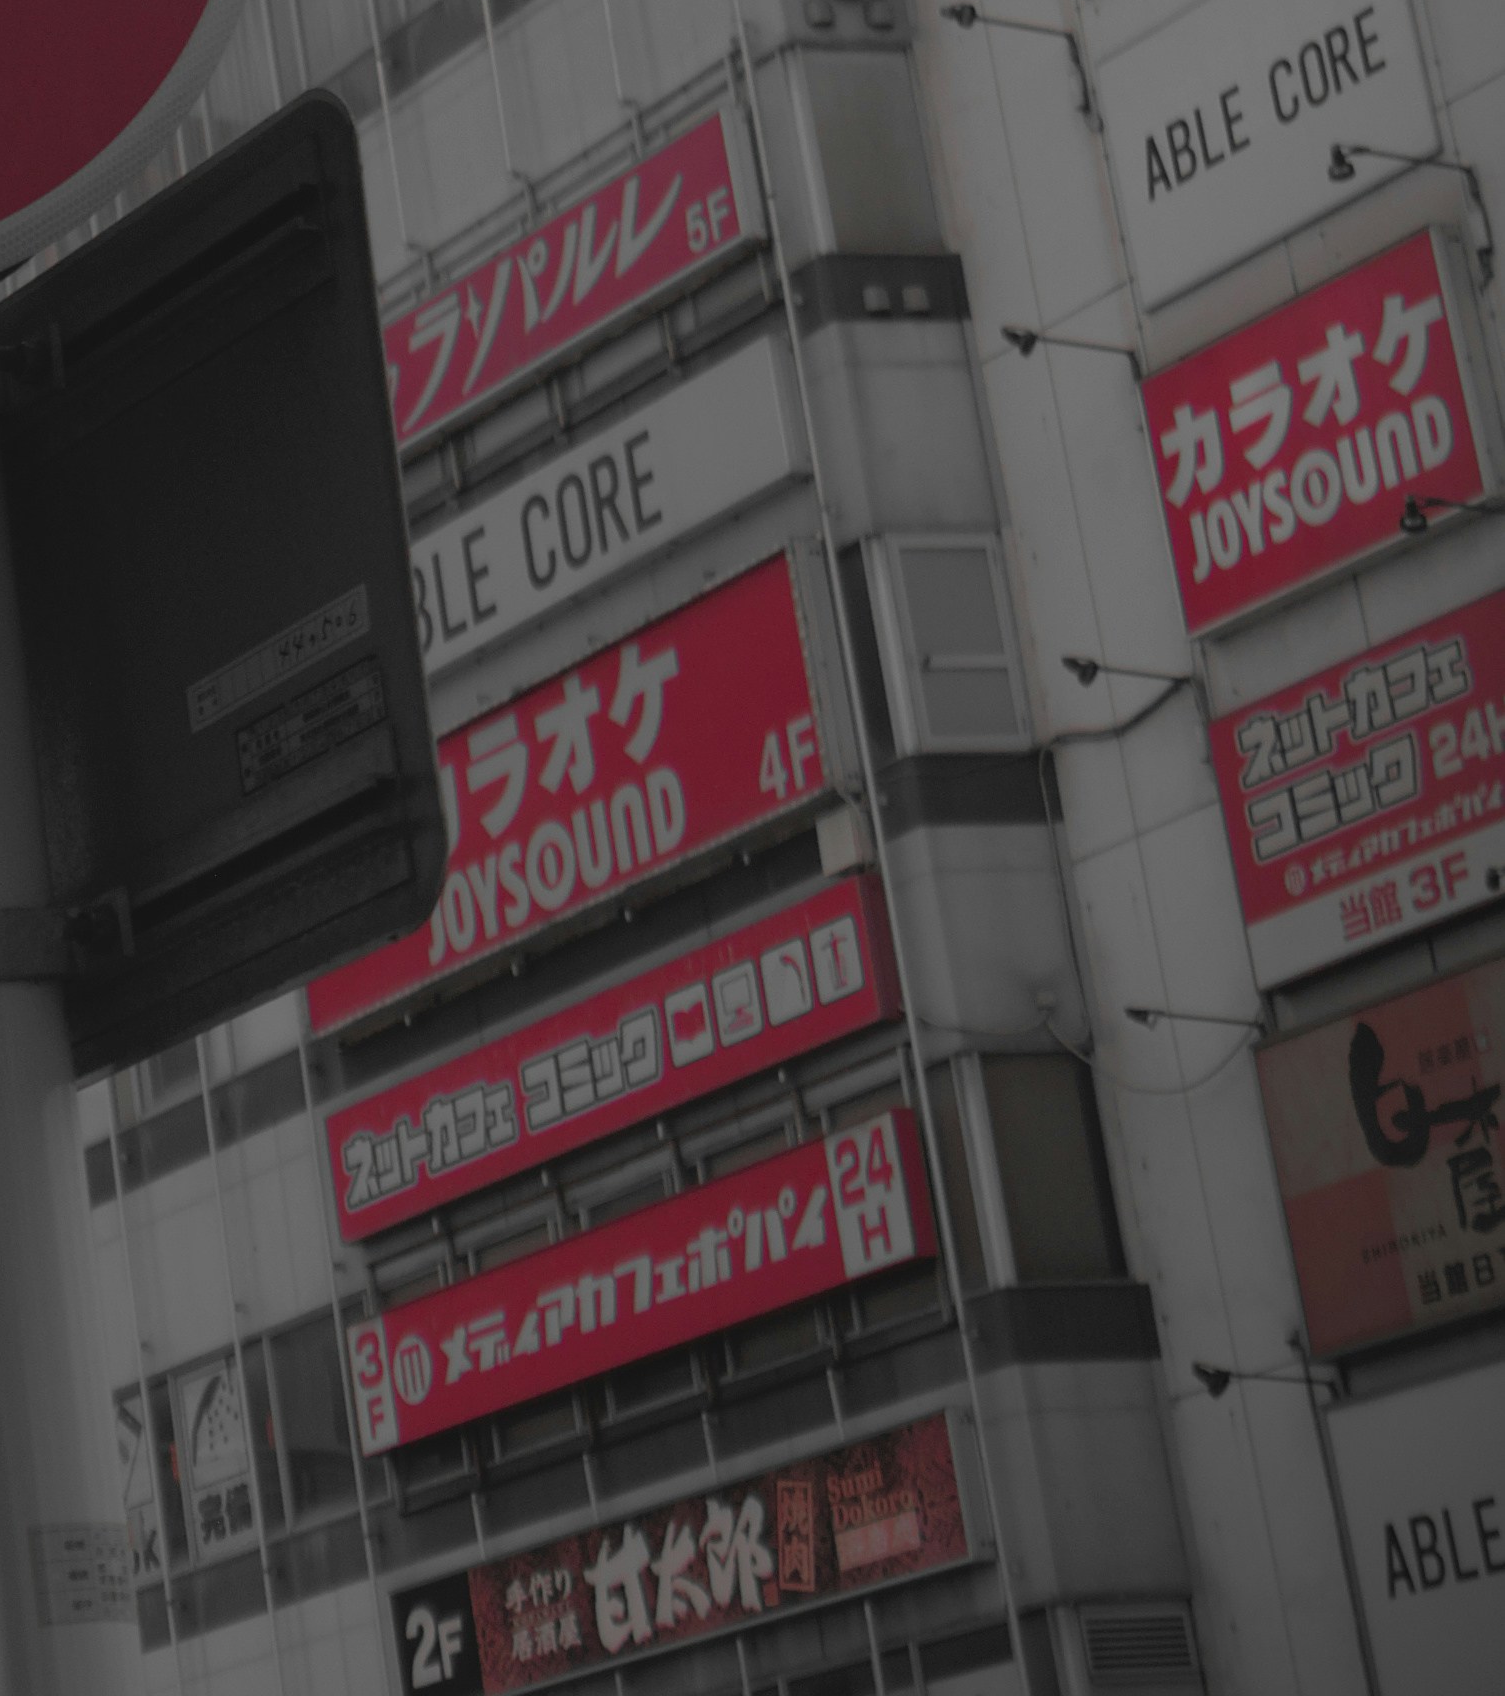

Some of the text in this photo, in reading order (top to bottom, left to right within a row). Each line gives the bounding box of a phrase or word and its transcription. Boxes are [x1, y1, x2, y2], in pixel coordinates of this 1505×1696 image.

[1144, 6, 1386, 202] ABLE CORE
[686, 185, 731, 252] 5F
[1160, 293, 1446, 508] カラオケ
[519, 429, 663, 591] CORE
[1190, 393, 1454, 585] JOYSOUND
[758, 714, 819, 801] 4F
[1238, 640, 1471, 790] ネットカフェ
[427, 766, 688, 967] JOYSOUND
[1246, 731, 1419, 864] コミック
[1408, 853, 1471, 909] 3F
[343, 1004, 660, 1213] ネットカフェ コミック
[440, 1184, 831, 1387] メディアカフェポパイ
[583, 1494, 778, 1655] 甘太郎
[1385, 1496, 1505, 1600] ABLE
[404, 1605, 464, 1690] 2F
